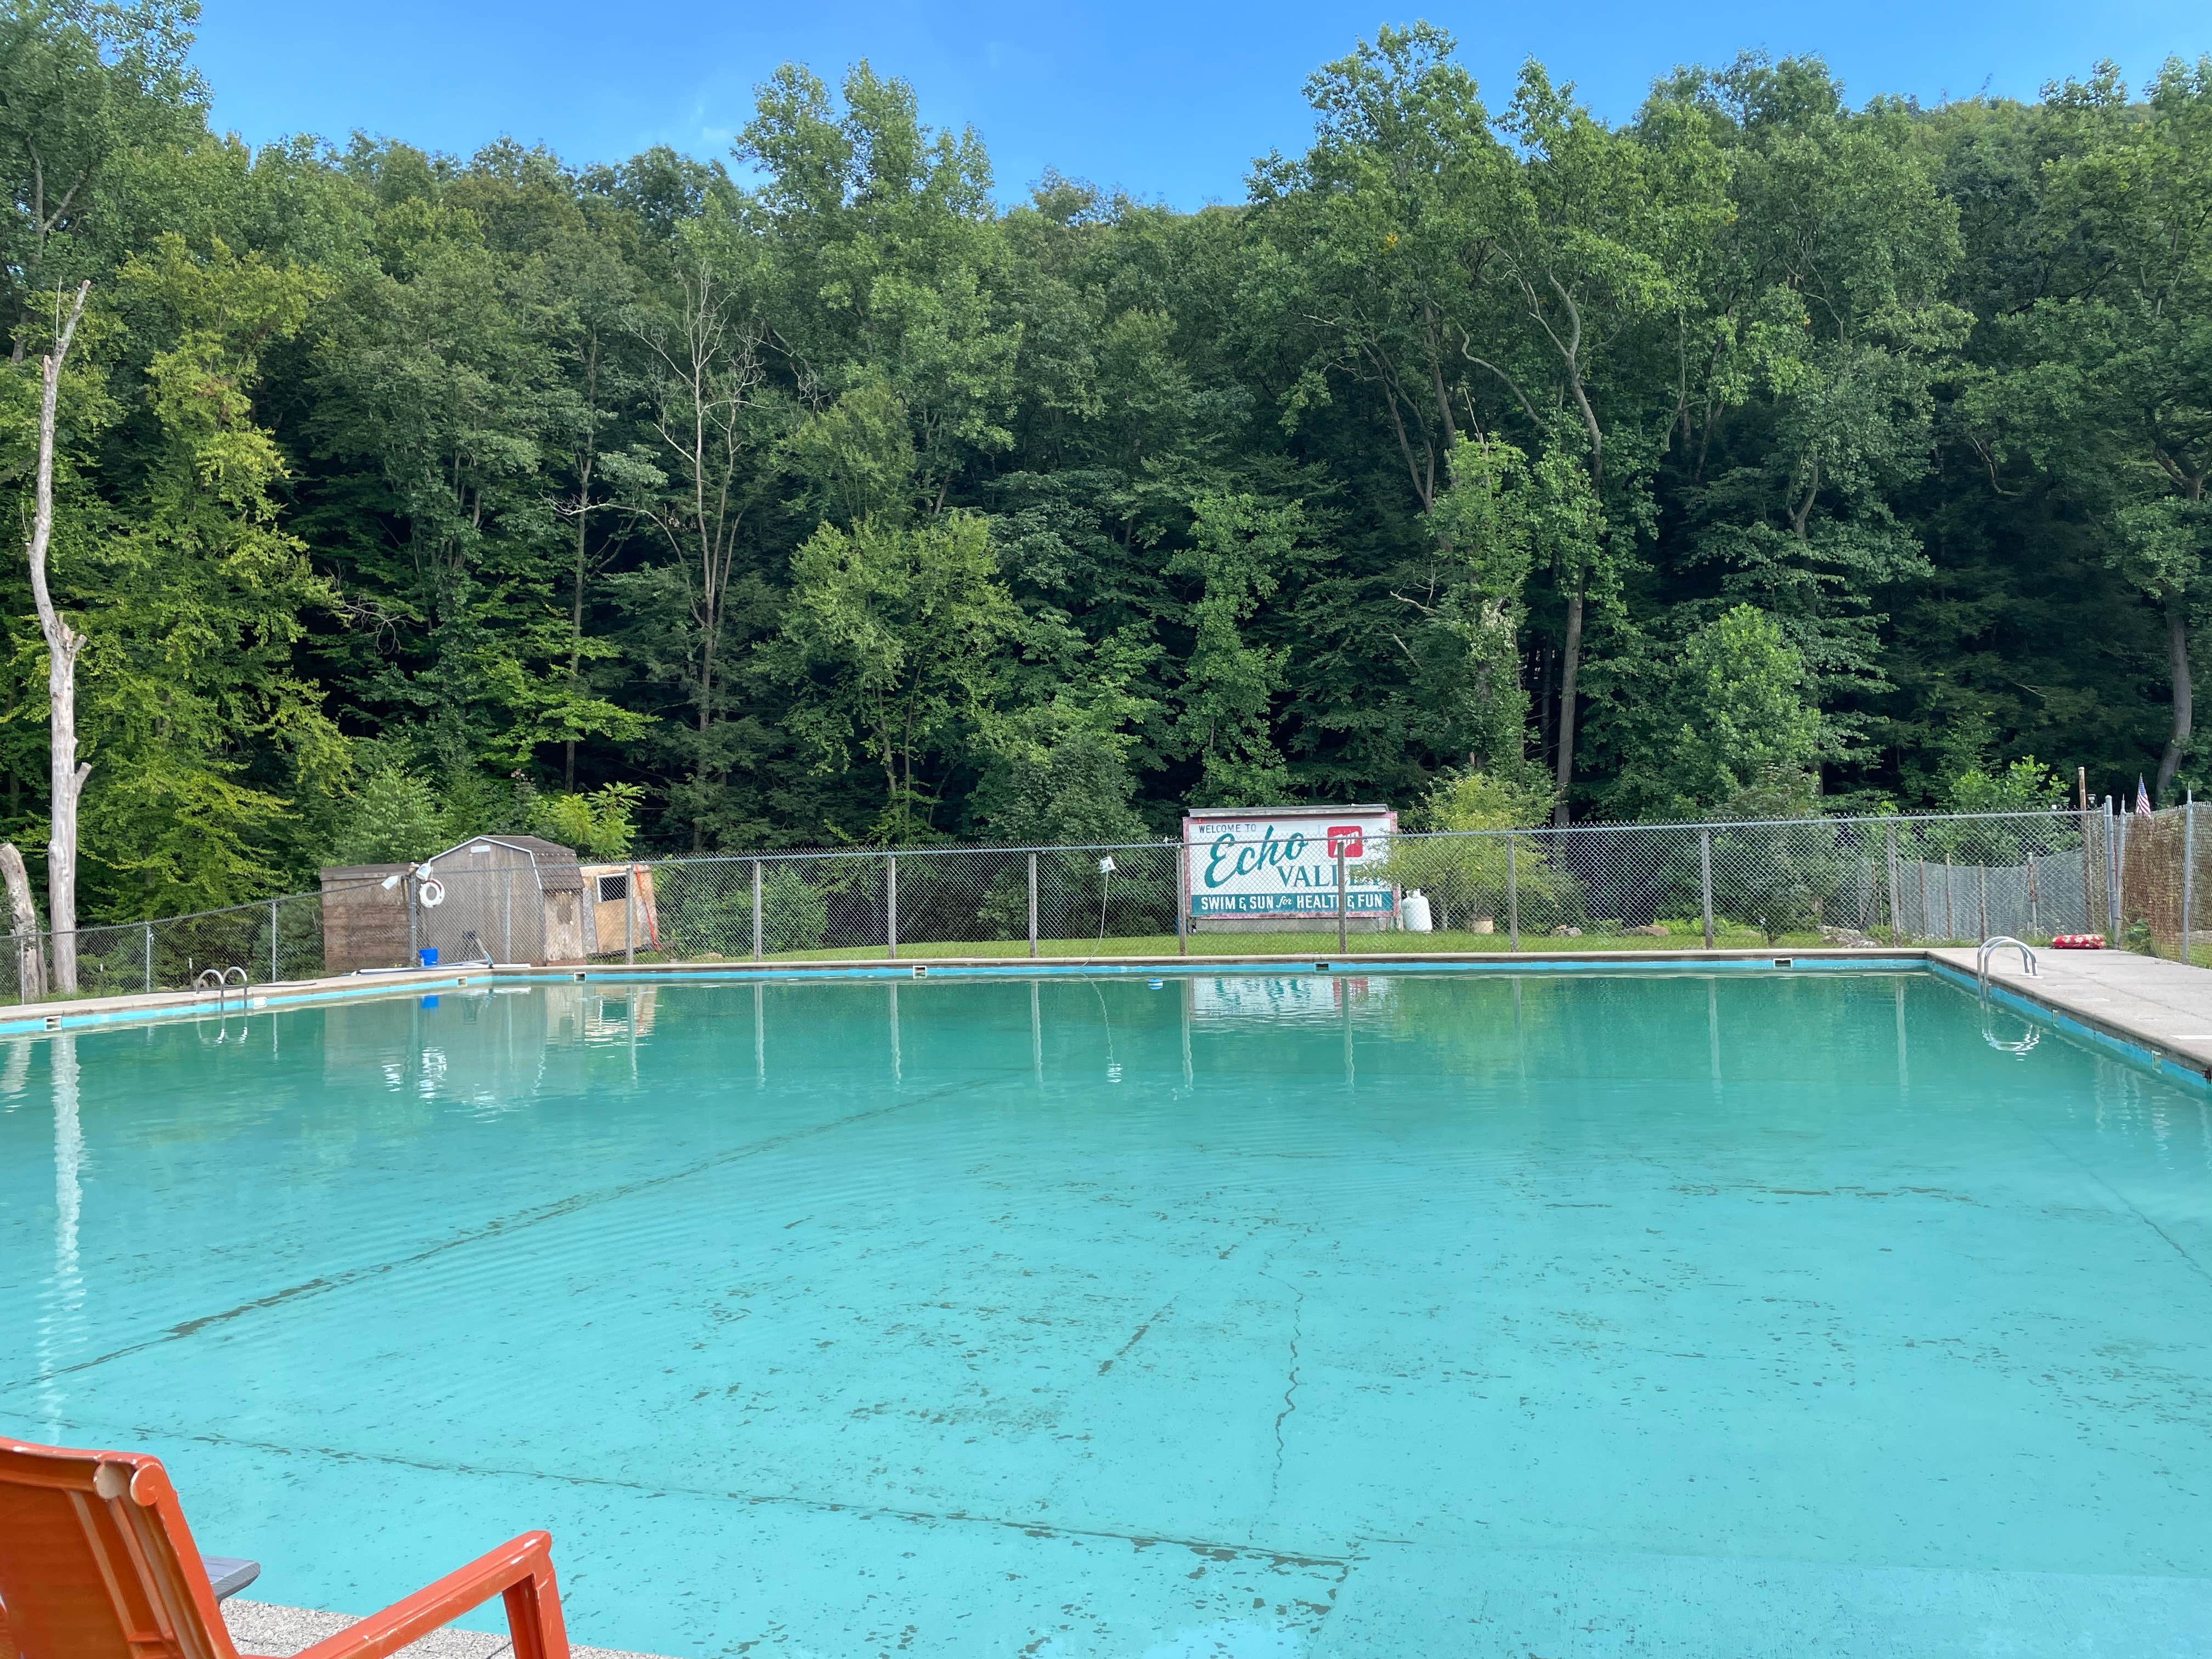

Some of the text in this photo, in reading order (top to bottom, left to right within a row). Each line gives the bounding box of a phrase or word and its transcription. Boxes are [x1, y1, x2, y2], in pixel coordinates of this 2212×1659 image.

[1199, 823, 1256, 833] WELCOME TO
[1204, 825, 1308, 888] Echo
[1201, 896, 1235, 910] SWIM
[1239, 897, 1246, 911] &
[1249, 895, 1273, 909] SUN
[1276, 895, 1292, 907] for
[1347, 895, 1355, 910] &
[1358, 894, 1383, 907] FUN
